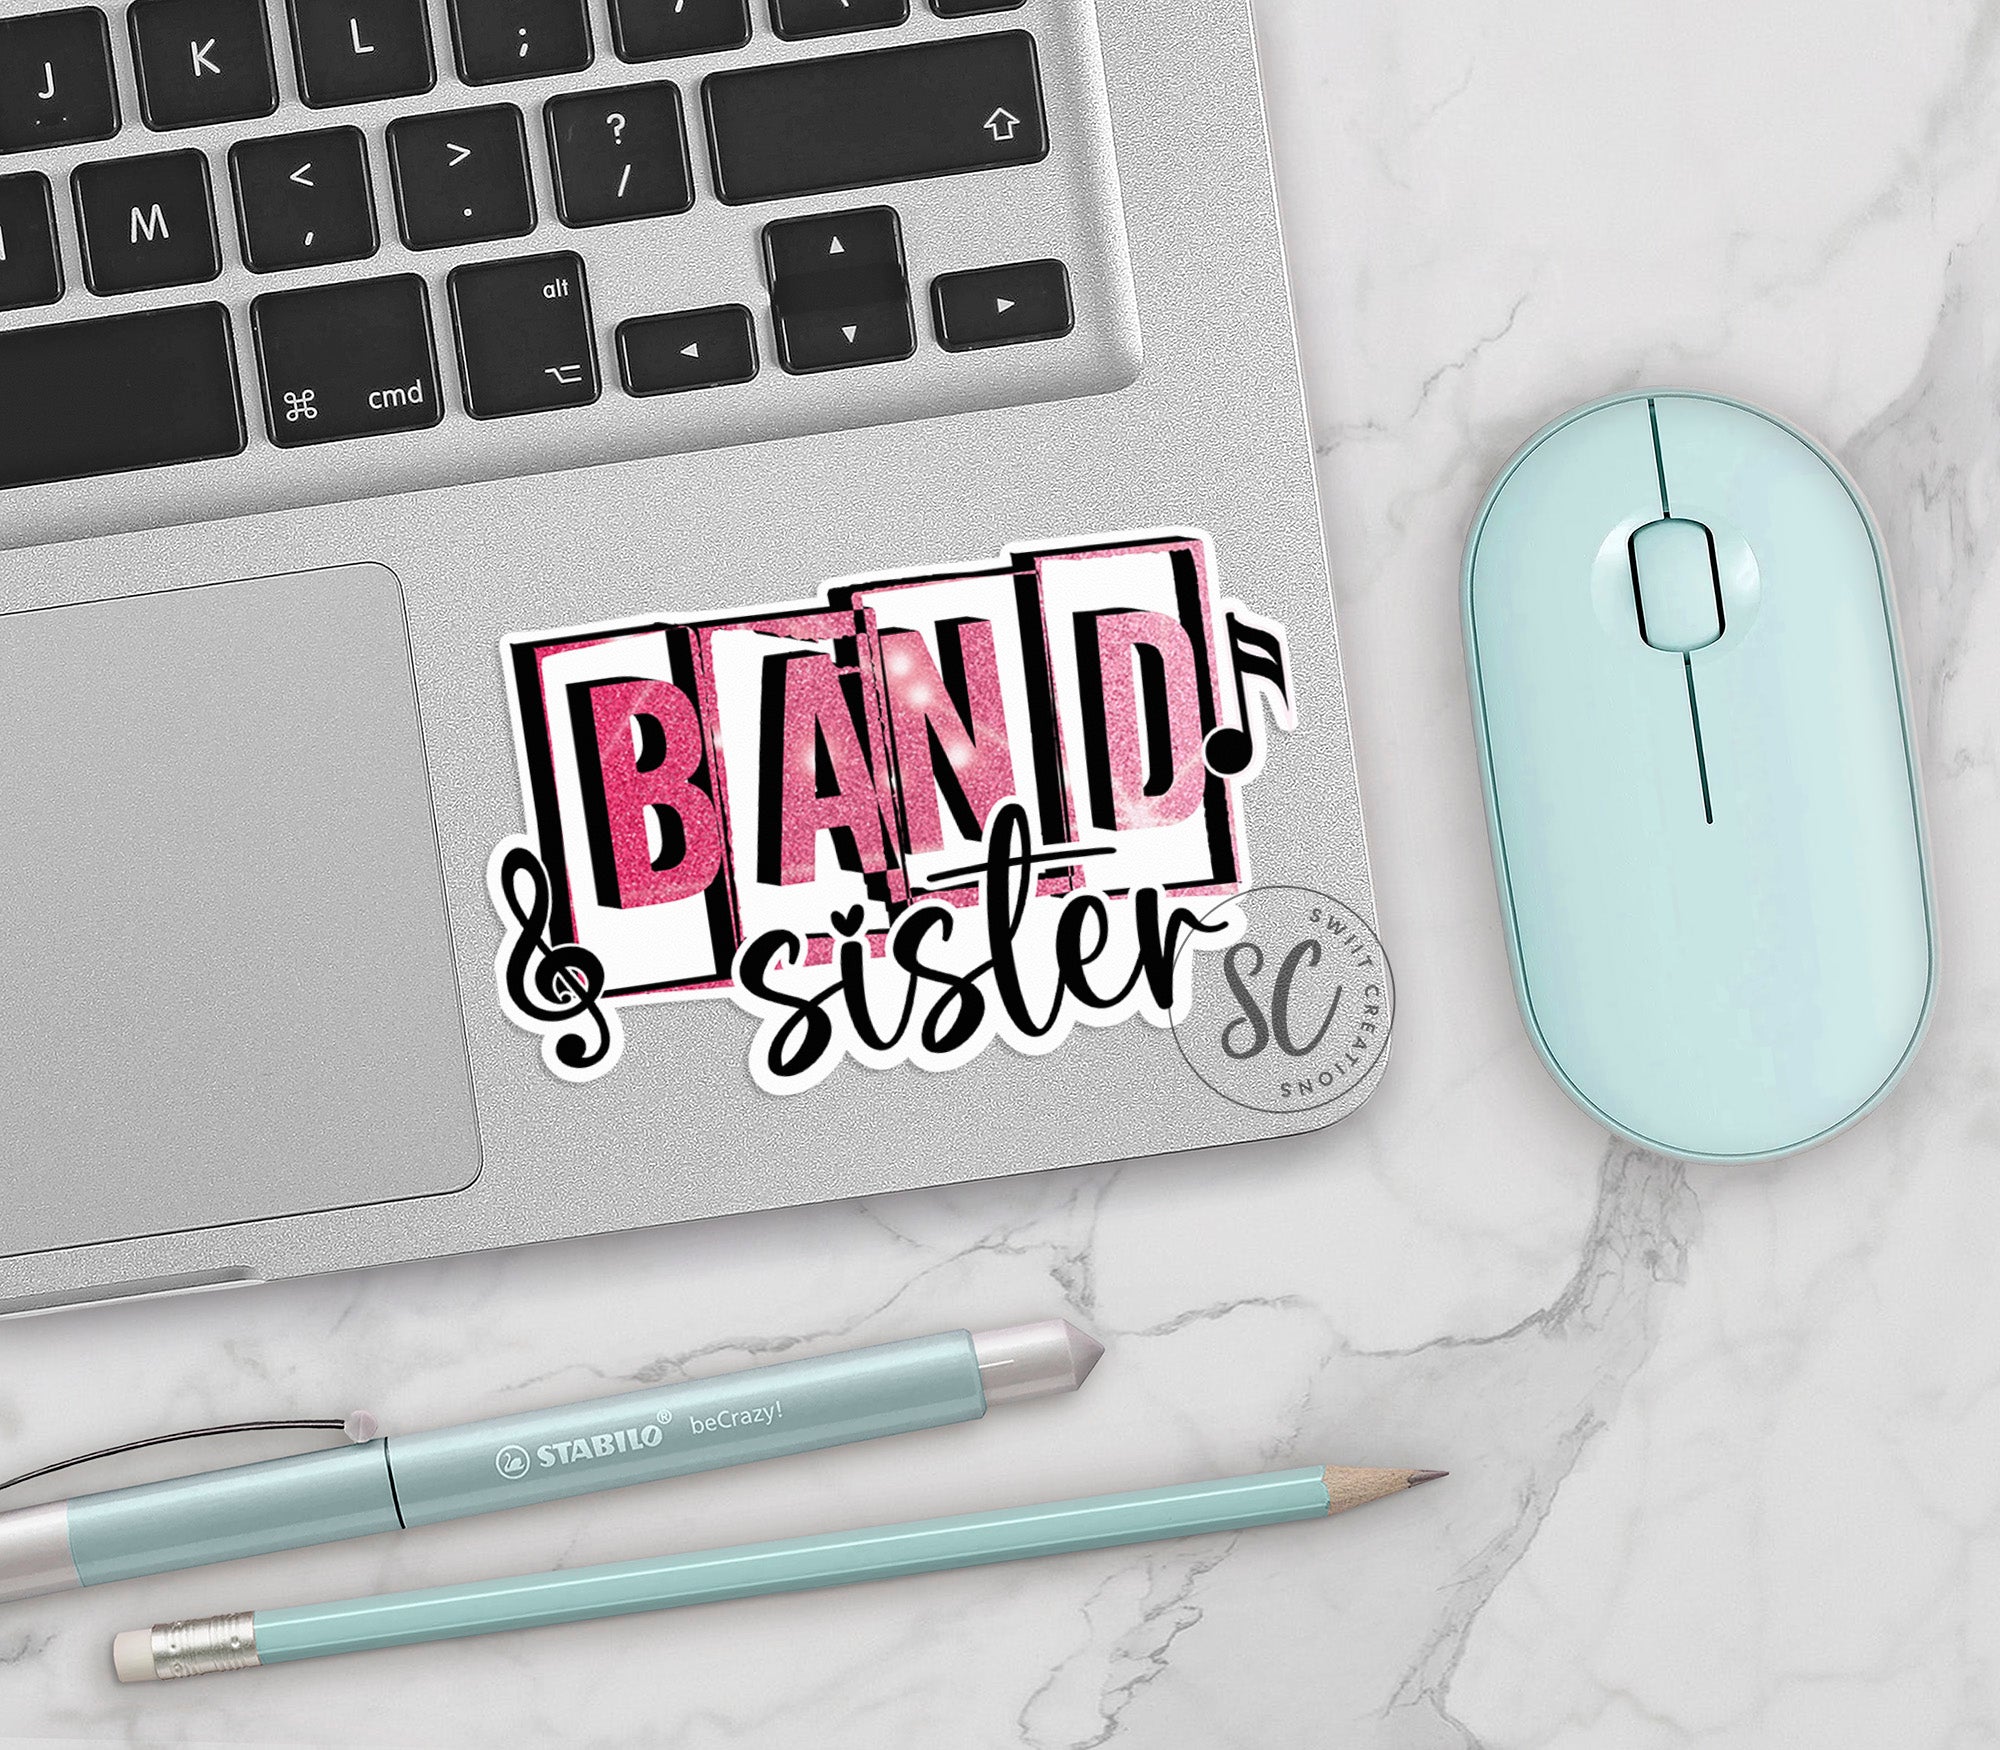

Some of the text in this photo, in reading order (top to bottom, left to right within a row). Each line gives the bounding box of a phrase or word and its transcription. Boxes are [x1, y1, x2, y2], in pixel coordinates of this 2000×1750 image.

[351, 18, 374, 53] L
[191, 39, 220, 76] K
[38, 62, 54, 98] J
[607, 114, 625, 144] ?
[131, 204, 169, 243] M
[543, 279, 568, 298] alt
[369, 379, 423, 409] cmd
[566, 607, 1208, 910] BAND
[735, 803, 1230, 1077] sister
[690, 1400, 783, 1435] beCrazy!
